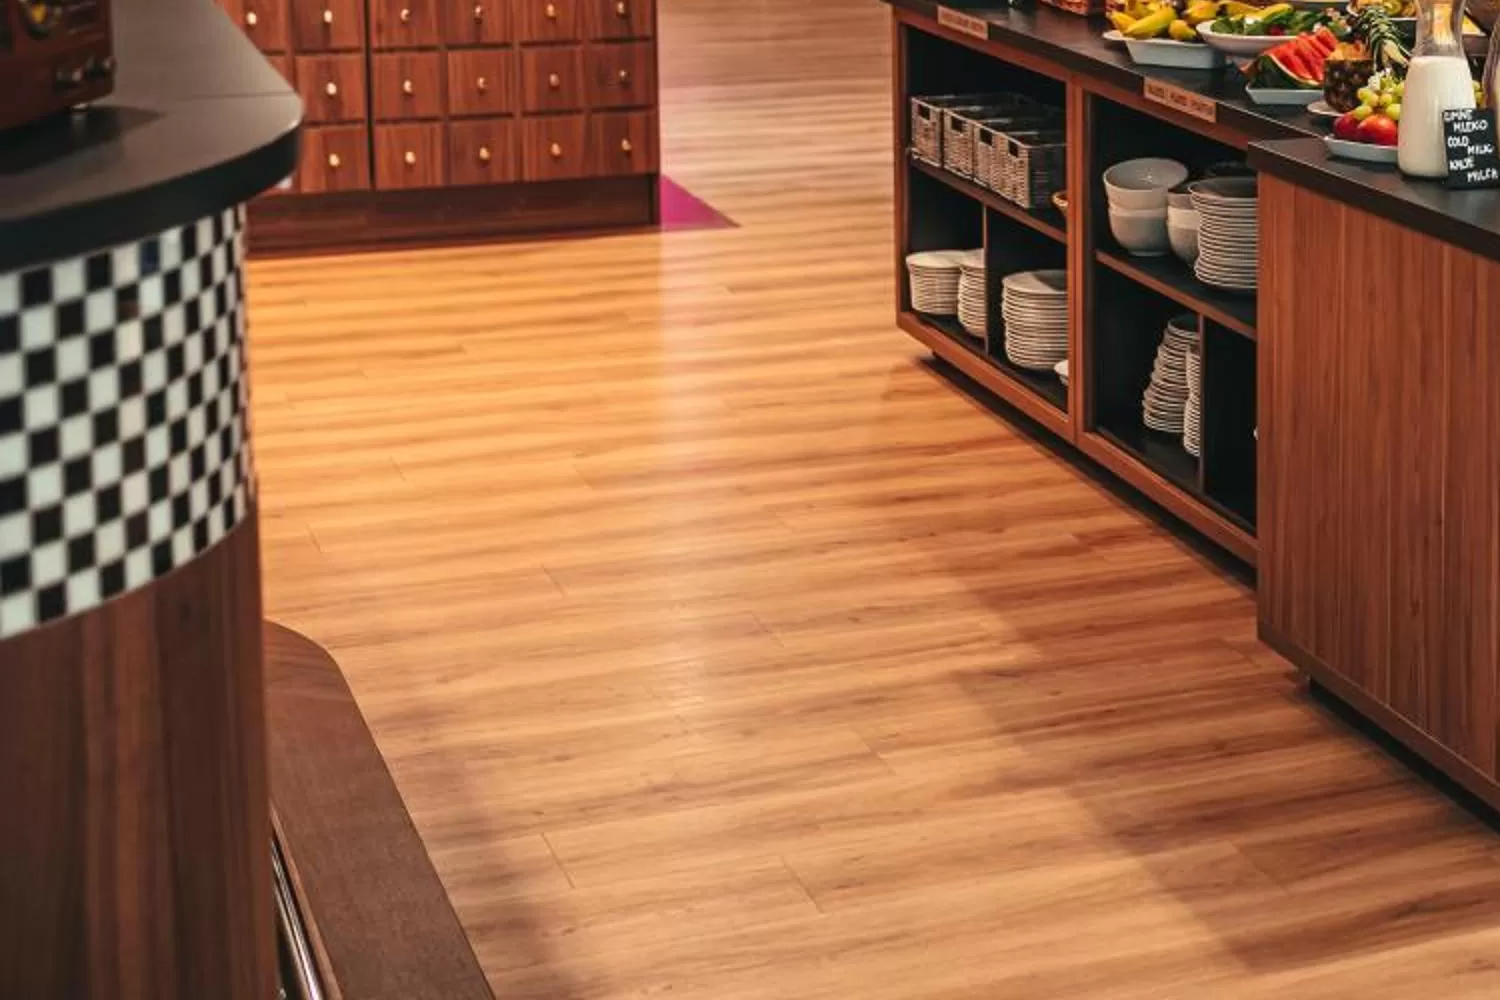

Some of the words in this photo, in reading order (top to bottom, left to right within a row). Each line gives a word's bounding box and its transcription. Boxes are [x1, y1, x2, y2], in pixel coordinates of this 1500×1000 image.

[1453, 120, 1488, 132] MLEKO
[1448, 136, 1469, 147] COLD
[1467, 144, 1494, 155] MILK
